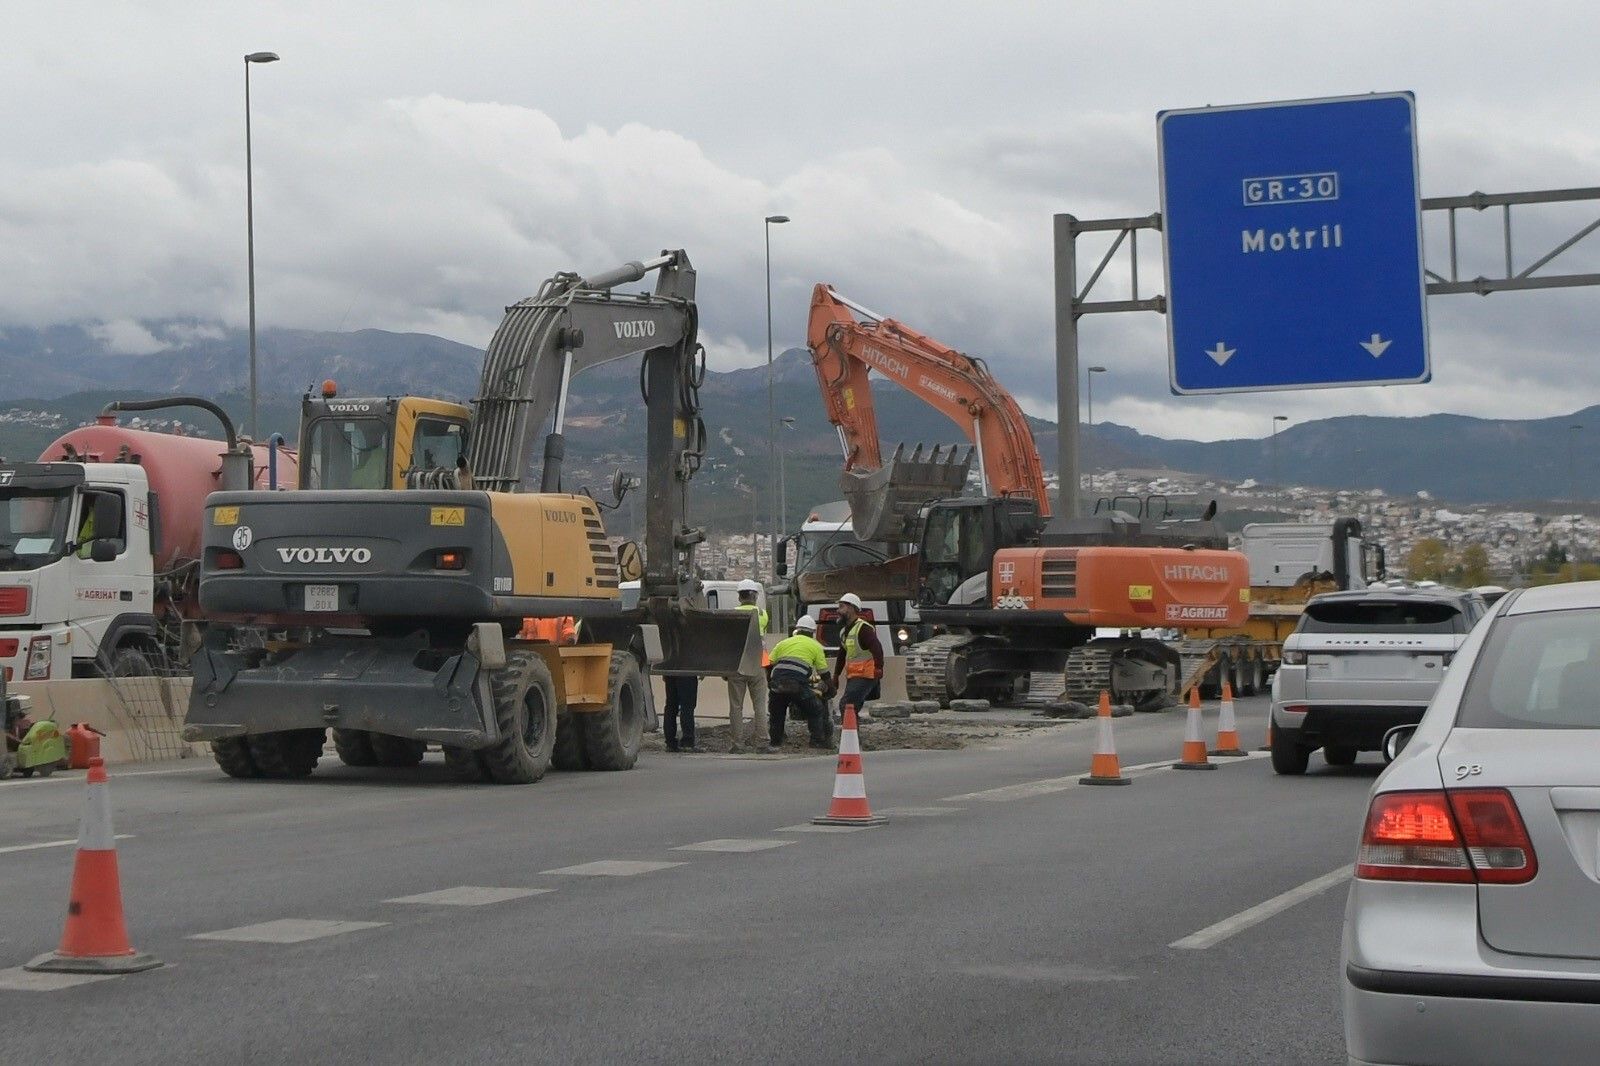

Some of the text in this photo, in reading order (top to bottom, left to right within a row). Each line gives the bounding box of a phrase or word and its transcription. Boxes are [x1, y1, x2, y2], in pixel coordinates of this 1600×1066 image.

[1248, 177, 1333, 202] GR-30
[1242, 224, 1342, 254] Motril
[613, 320, 656, 339] VOLVO
[862, 344, 909, 379] HITACHI
[328, 404, 370, 412] VOLVO
[544, 509, 577, 524] VOLVO
[276, 547, 372, 564] VOLVO
[1164, 565, 1228, 581] HITACHI
